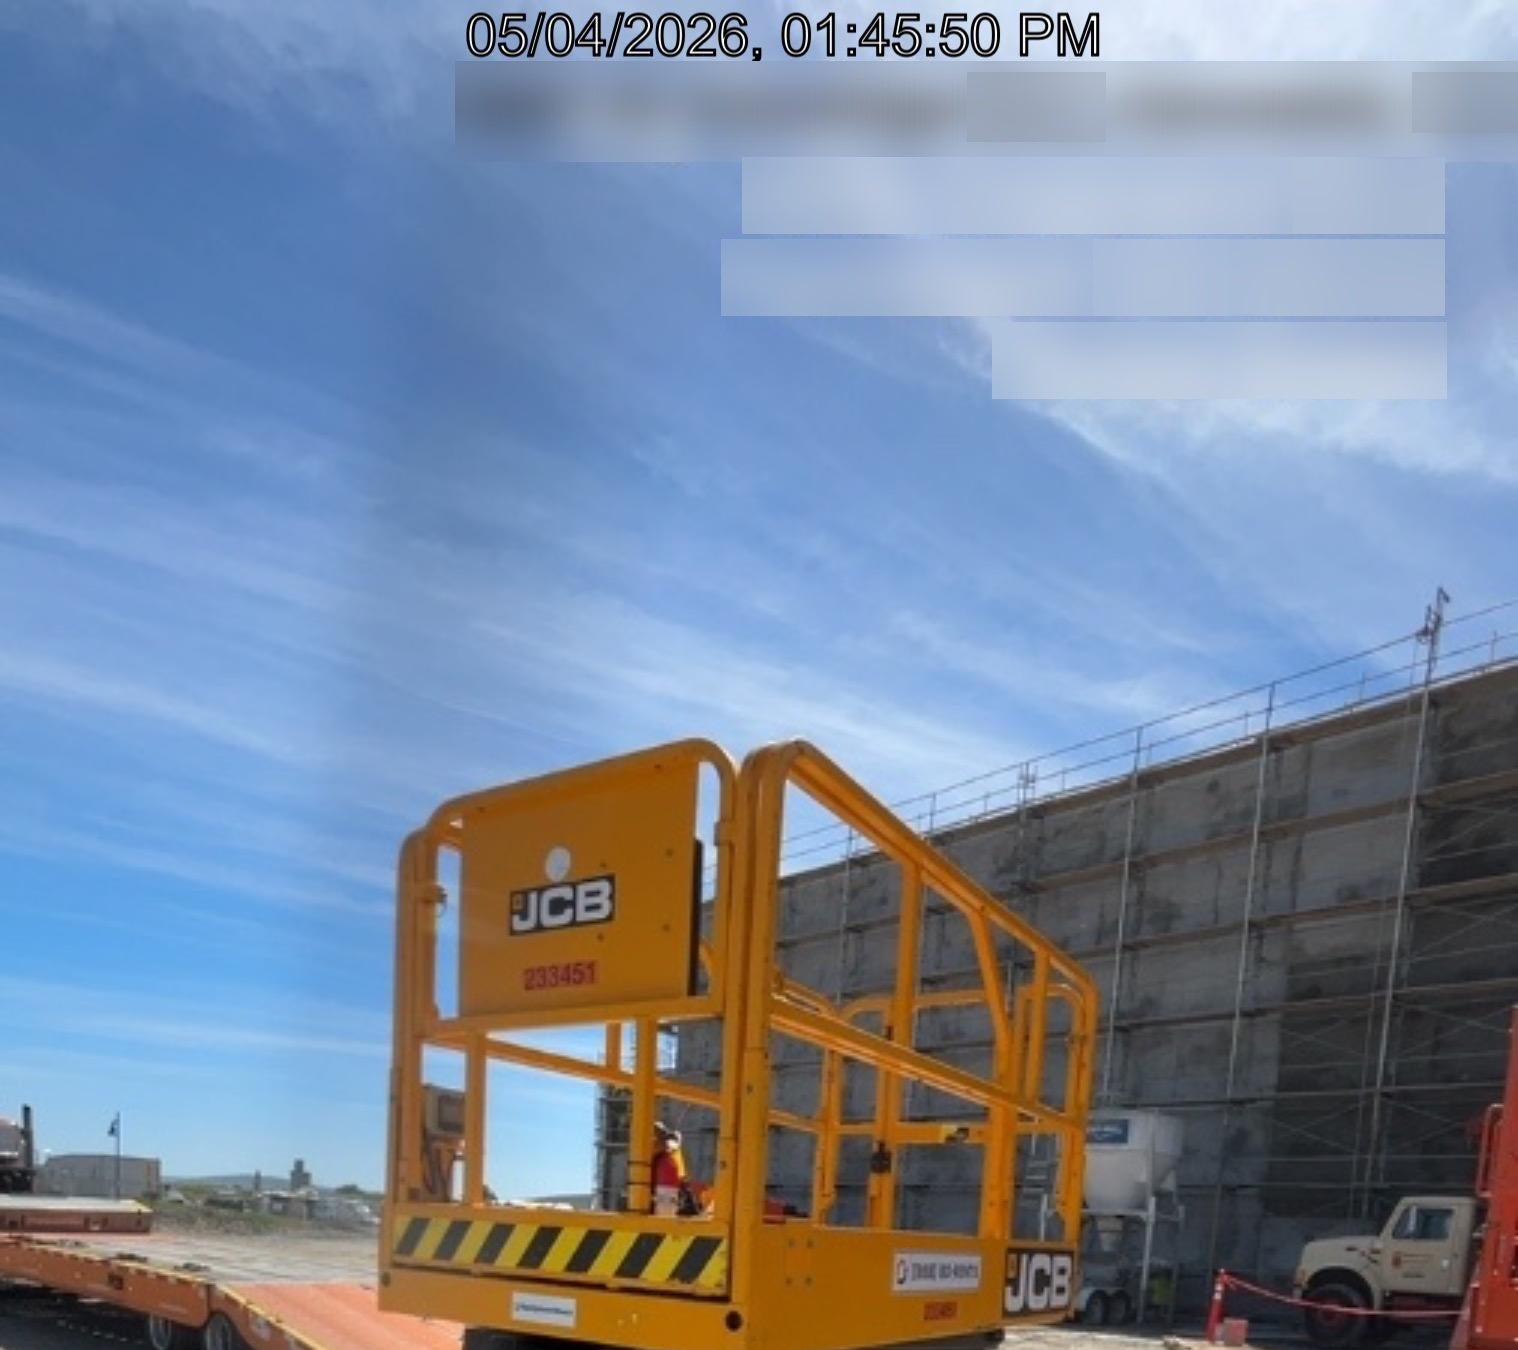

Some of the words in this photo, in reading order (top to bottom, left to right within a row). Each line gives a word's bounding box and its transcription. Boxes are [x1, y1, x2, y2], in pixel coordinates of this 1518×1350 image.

[511, 879, 613, 932] JCB
[524, 961, 595, 990] 233451
[1004, 1252, 1072, 1312] JCB
